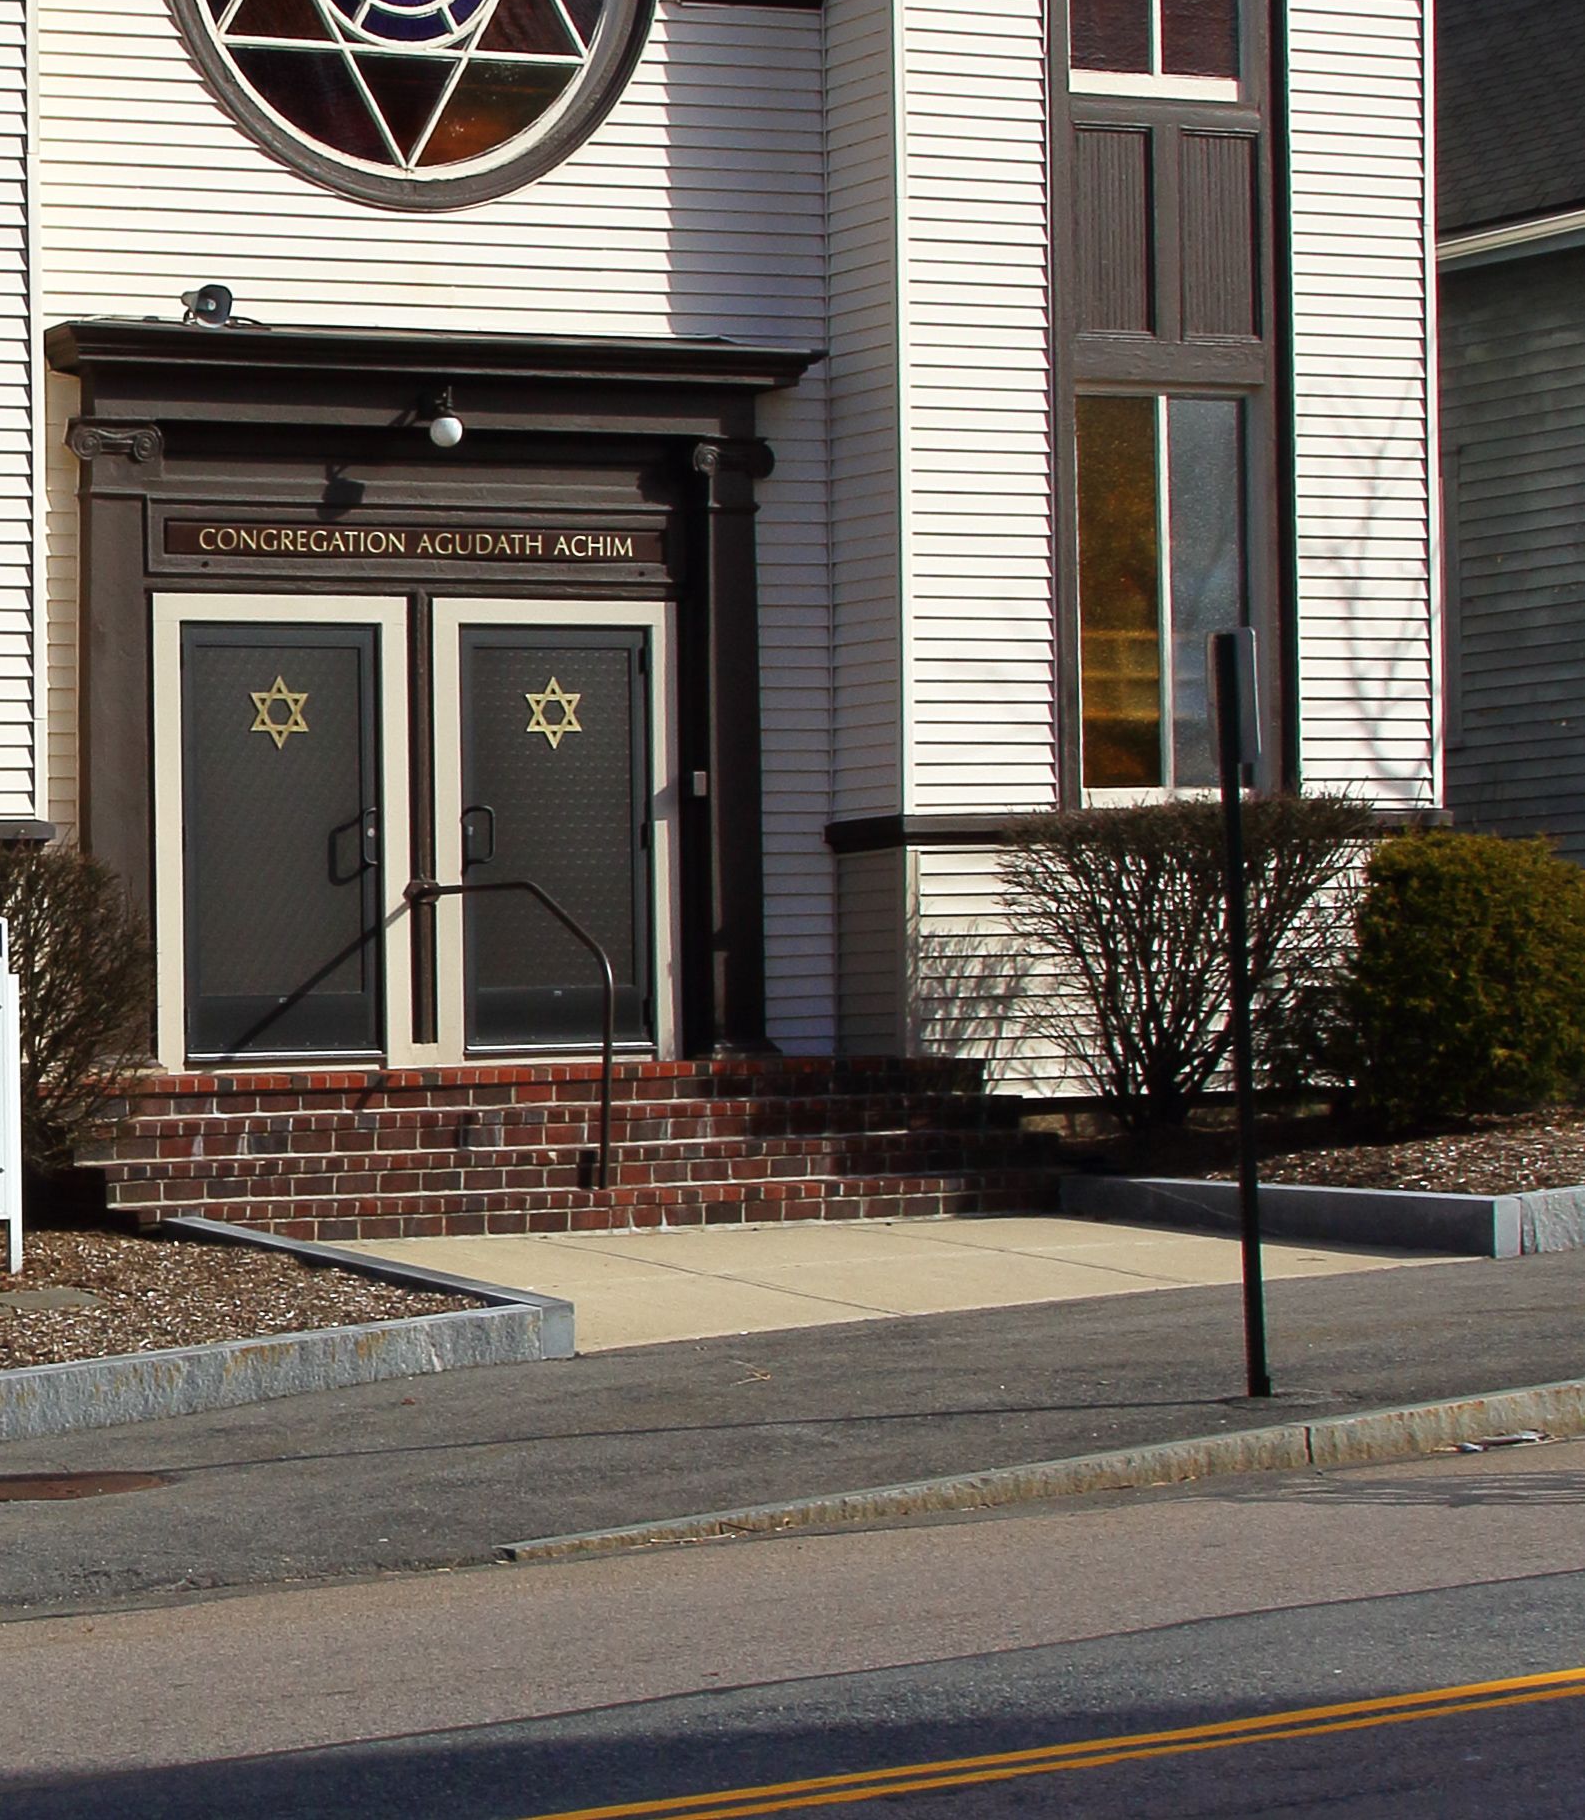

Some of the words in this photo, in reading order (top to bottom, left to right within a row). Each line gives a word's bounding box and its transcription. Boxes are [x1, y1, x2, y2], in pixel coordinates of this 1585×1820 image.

[199, 528, 405, 554] CONGREGATION
[417, 532, 542, 556] AGUDATH
[553, 535, 633, 557] ACHIM
